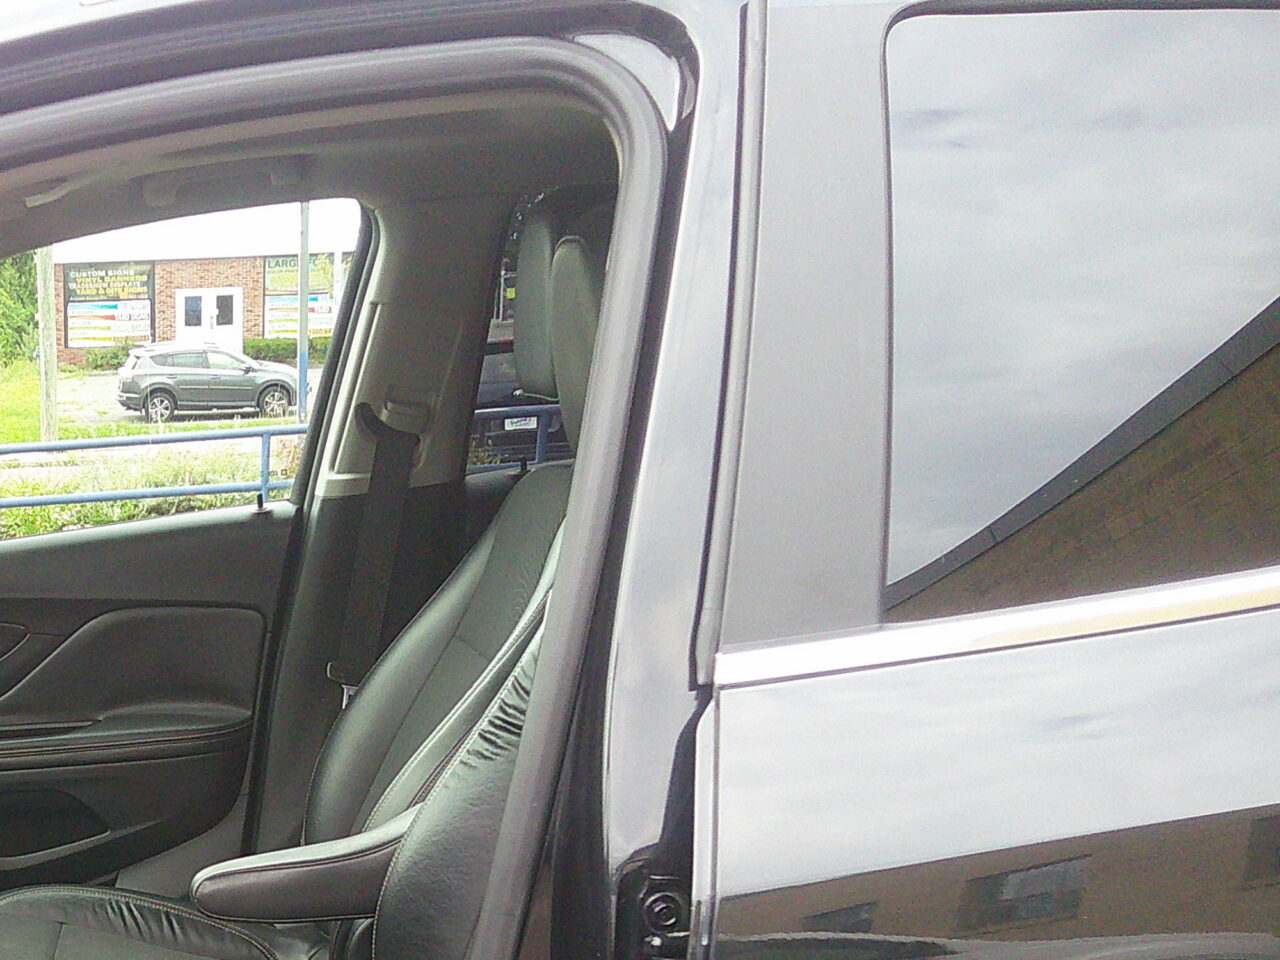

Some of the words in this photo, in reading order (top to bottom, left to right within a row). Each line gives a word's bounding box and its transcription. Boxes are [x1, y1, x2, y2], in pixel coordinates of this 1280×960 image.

[268, 258, 298, 269] LARG
[70, 270, 106, 278] CUSTOM
[108, 269, 135, 277] SIGNS
